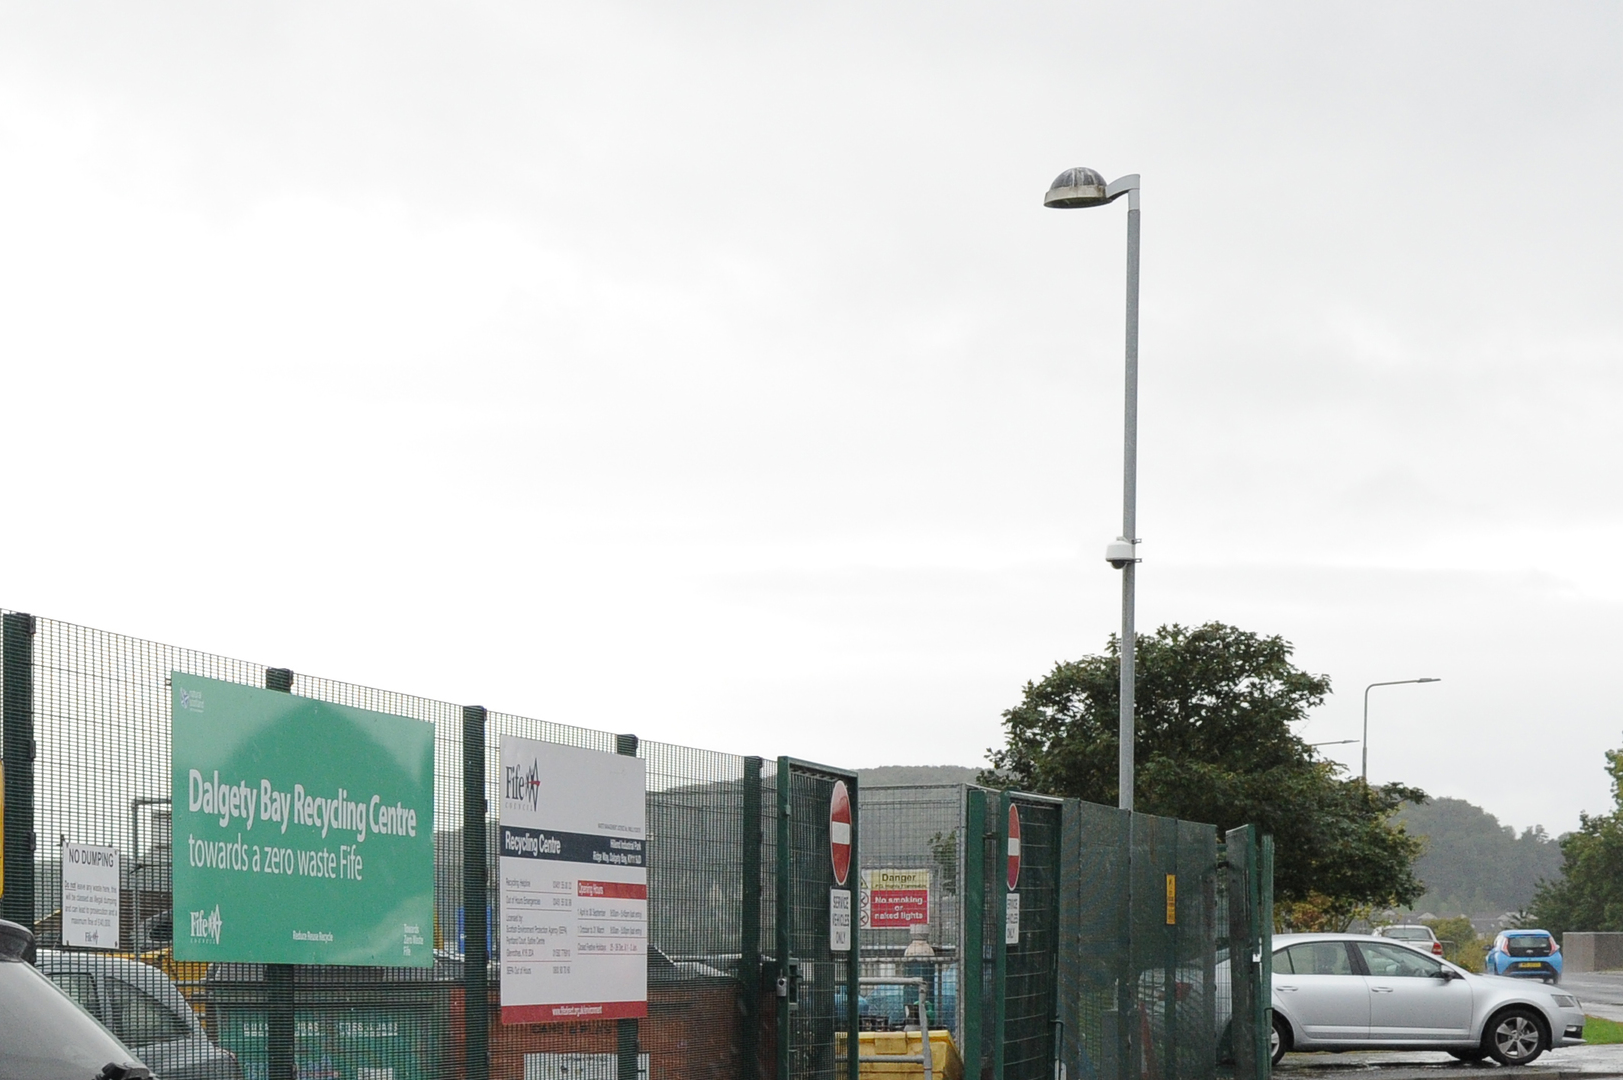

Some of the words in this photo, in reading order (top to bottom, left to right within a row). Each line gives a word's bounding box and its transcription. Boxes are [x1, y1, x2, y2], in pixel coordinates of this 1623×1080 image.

[506, 764, 524, 801] Fife
[189, 769, 257, 830] Dalgety
[260, 779, 291, 835] Bay
[294, 783, 366, 842] Recycling
[369, 795, 417, 837] Centre
[505, 802, 533, 812] COUNCIL
[505, 830, 538, 857] Recycling
[539, 833, 561, 854] Centre
[69, 848, 80, 865] NO
[81, 850, 114, 868] DUMPING
[188, 832, 248, 872] towards
[252, 844, 260, 873] a
[264, 847, 294, 876] zero
[297, 847, 336, 879] waste
[340, 844, 363, 881] Fife
[882, 873, 916, 883] Danger
[833, 895, 849, 909] SERVICE
[888, 896, 923, 905] smoking
[190, 909, 208, 938] Fife
[832, 913, 850, 927] VEHICLES
[900, 912, 923, 921] lights
[318, 931, 334, 943] Recycle
[403, 934, 413, 945] Zero
[412, 935, 424, 945] Waste
[835, 931, 846, 944] ONLY
